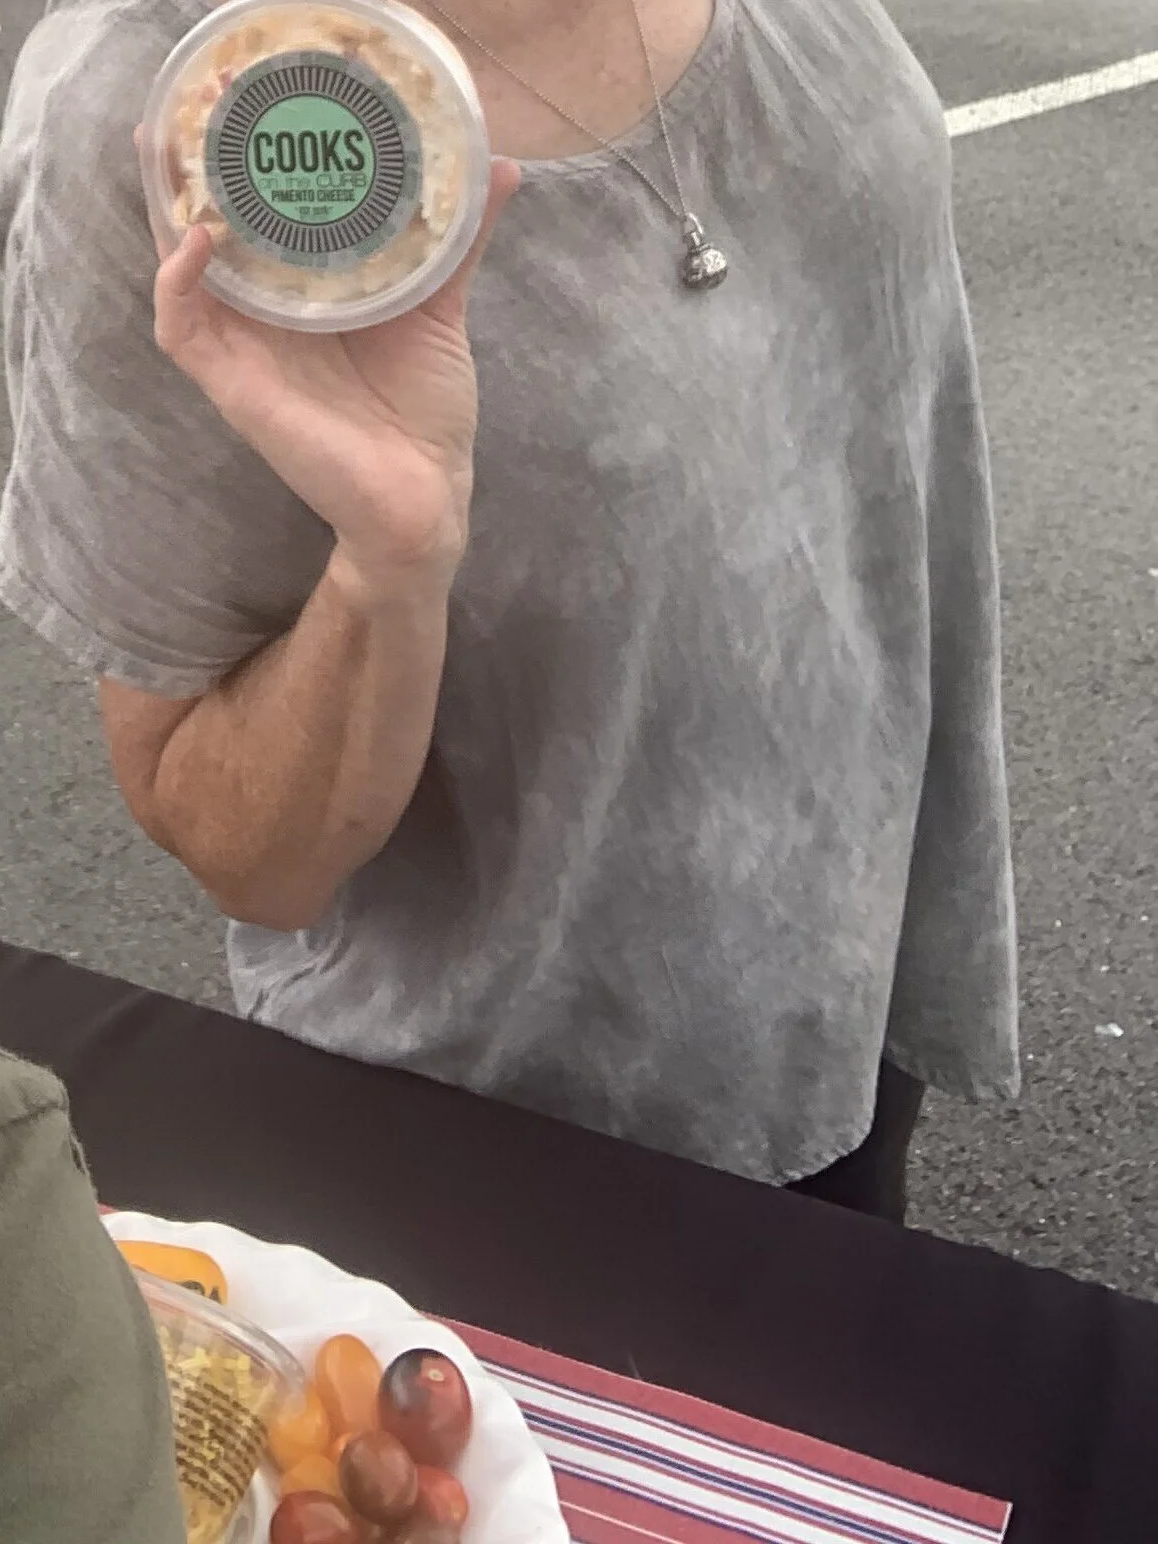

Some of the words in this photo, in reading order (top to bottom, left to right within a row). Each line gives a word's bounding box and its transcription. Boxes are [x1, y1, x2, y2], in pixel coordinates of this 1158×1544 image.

[253, 129, 365, 174] COOKS
[316, 172, 367, 188] CURB
[271, 189, 315, 203] PIMENTO
[317, 188, 355, 202] CHEESE
